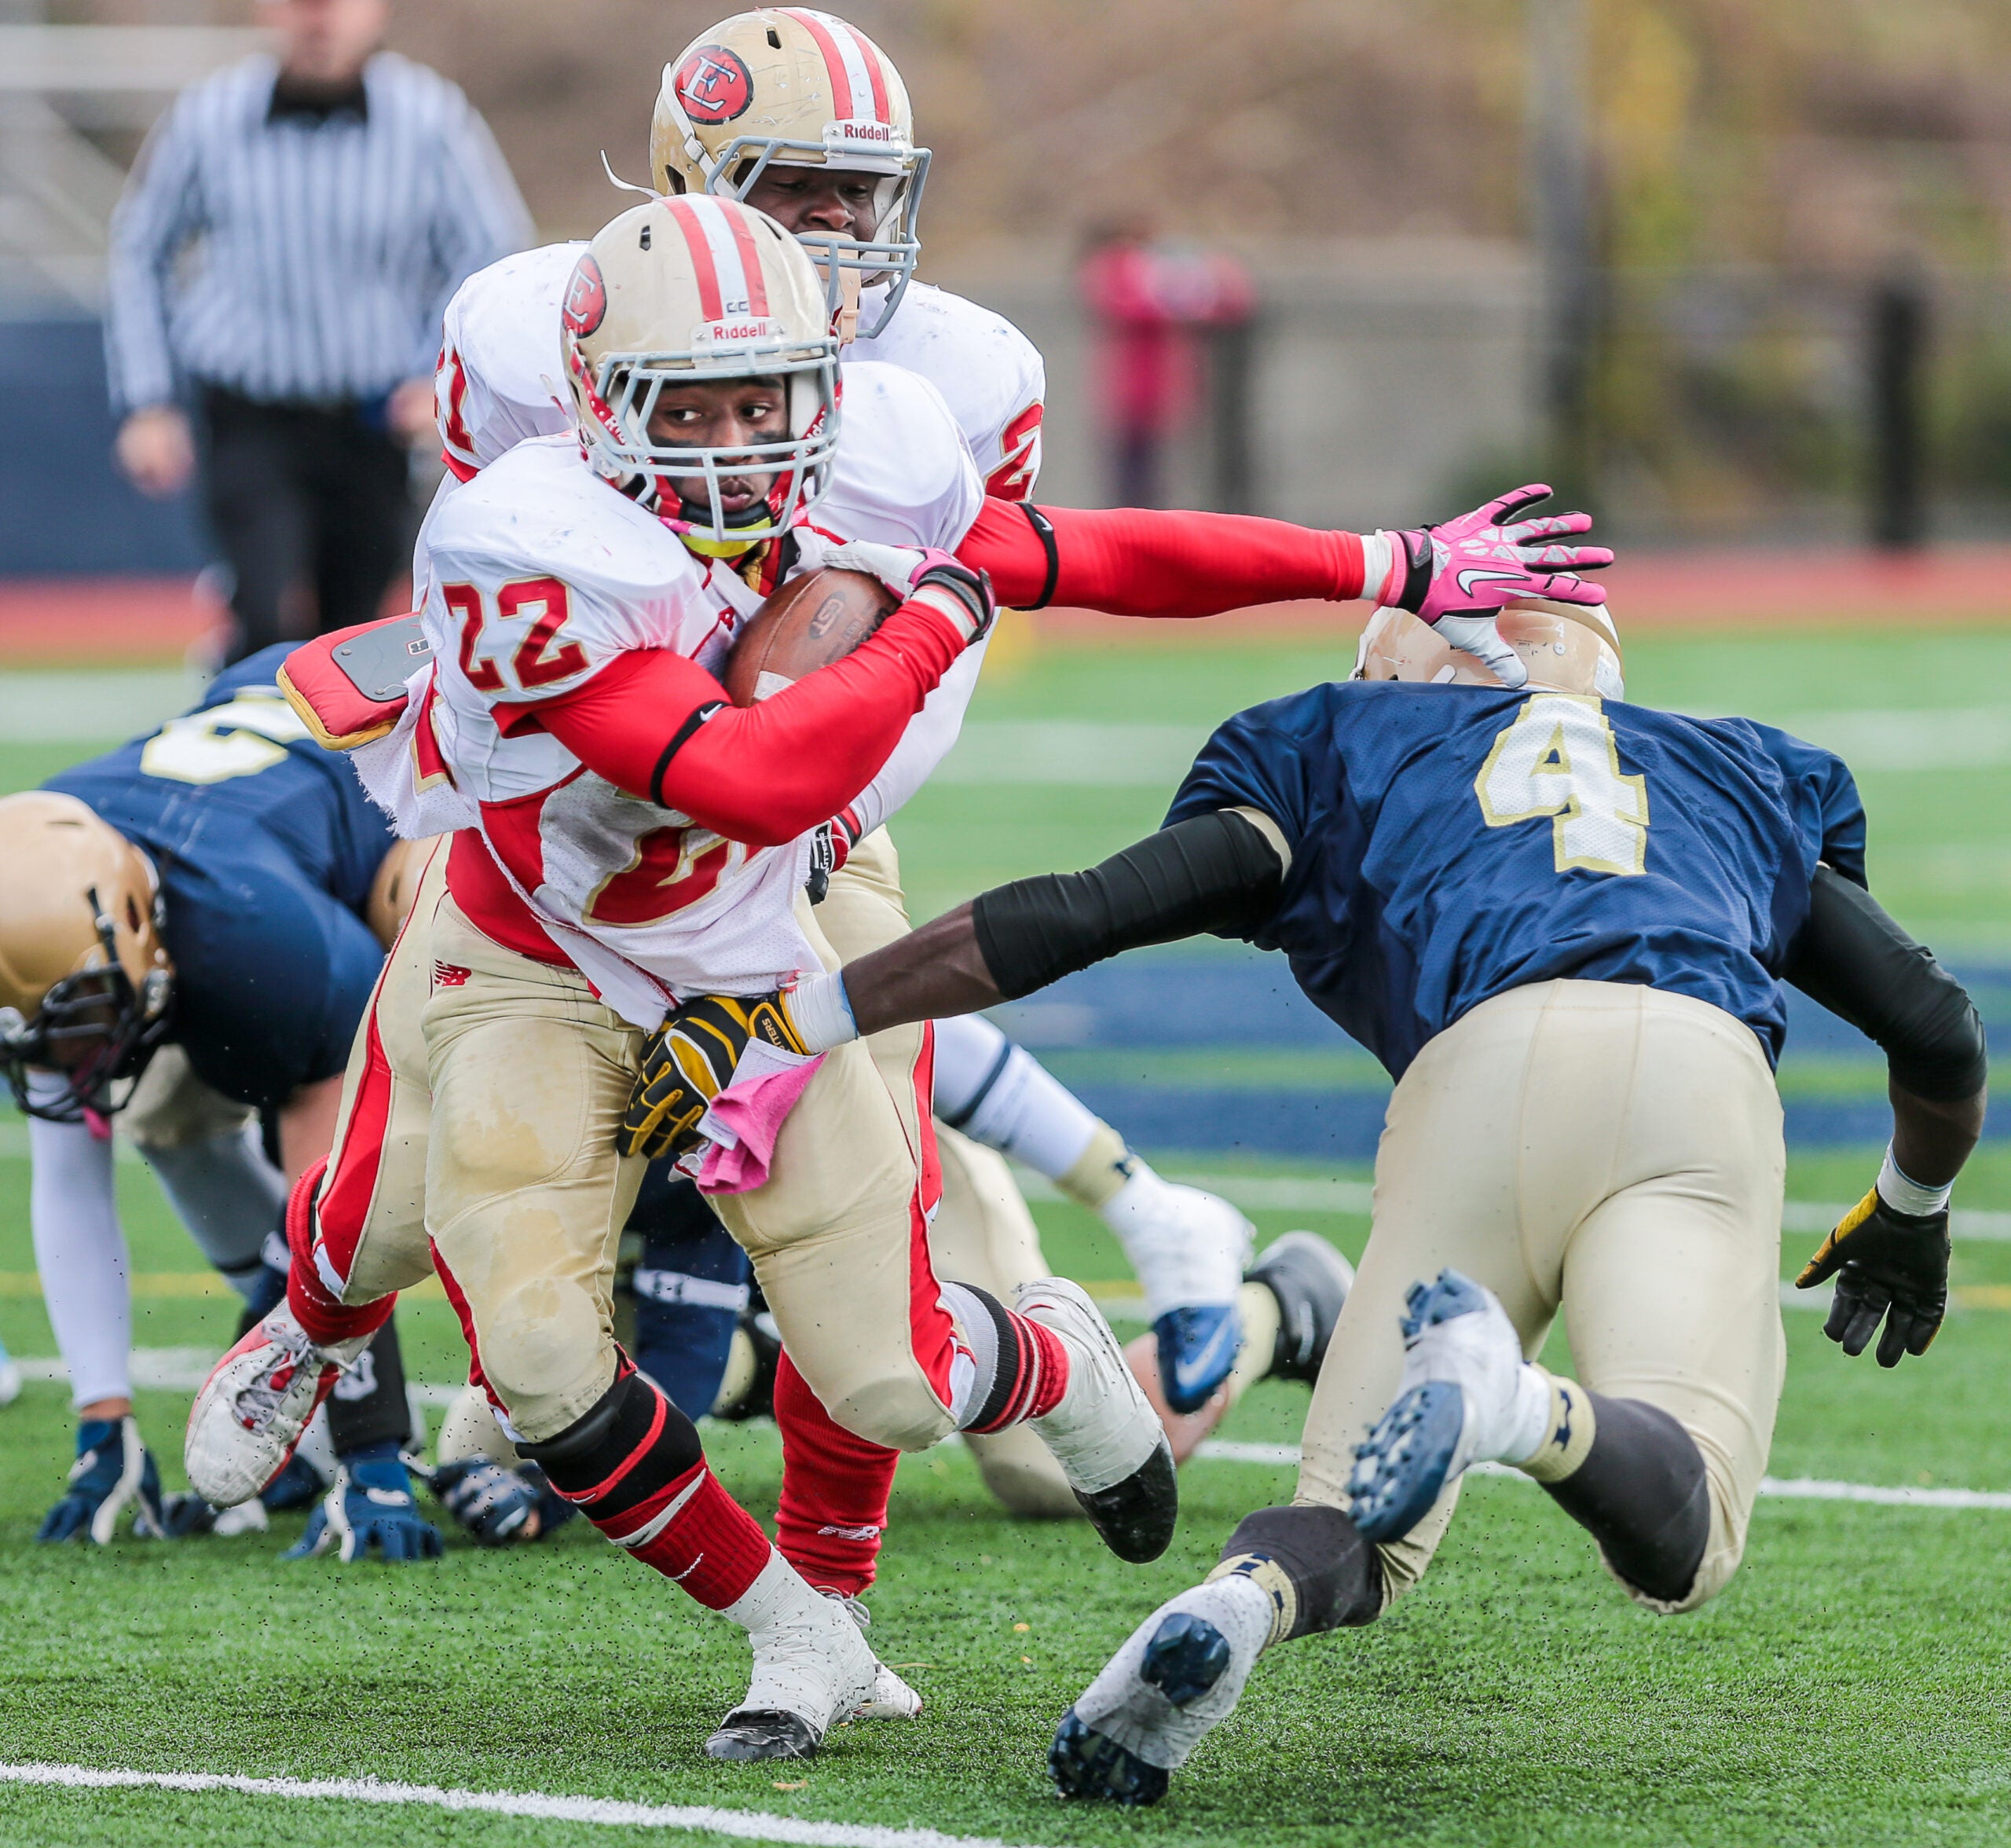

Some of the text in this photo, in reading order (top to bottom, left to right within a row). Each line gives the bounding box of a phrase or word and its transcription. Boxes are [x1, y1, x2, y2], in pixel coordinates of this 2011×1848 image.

[679, 56, 737, 112] E
[844, 123, 889, 141] Riddell
[564, 273, 597, 324] E
[713, 321, 767, 339] Riddell
[441, 574, 592, 693] 22
[1555, 622, 1565, 638] 4
[1473, 692, 1650, 876] 4
